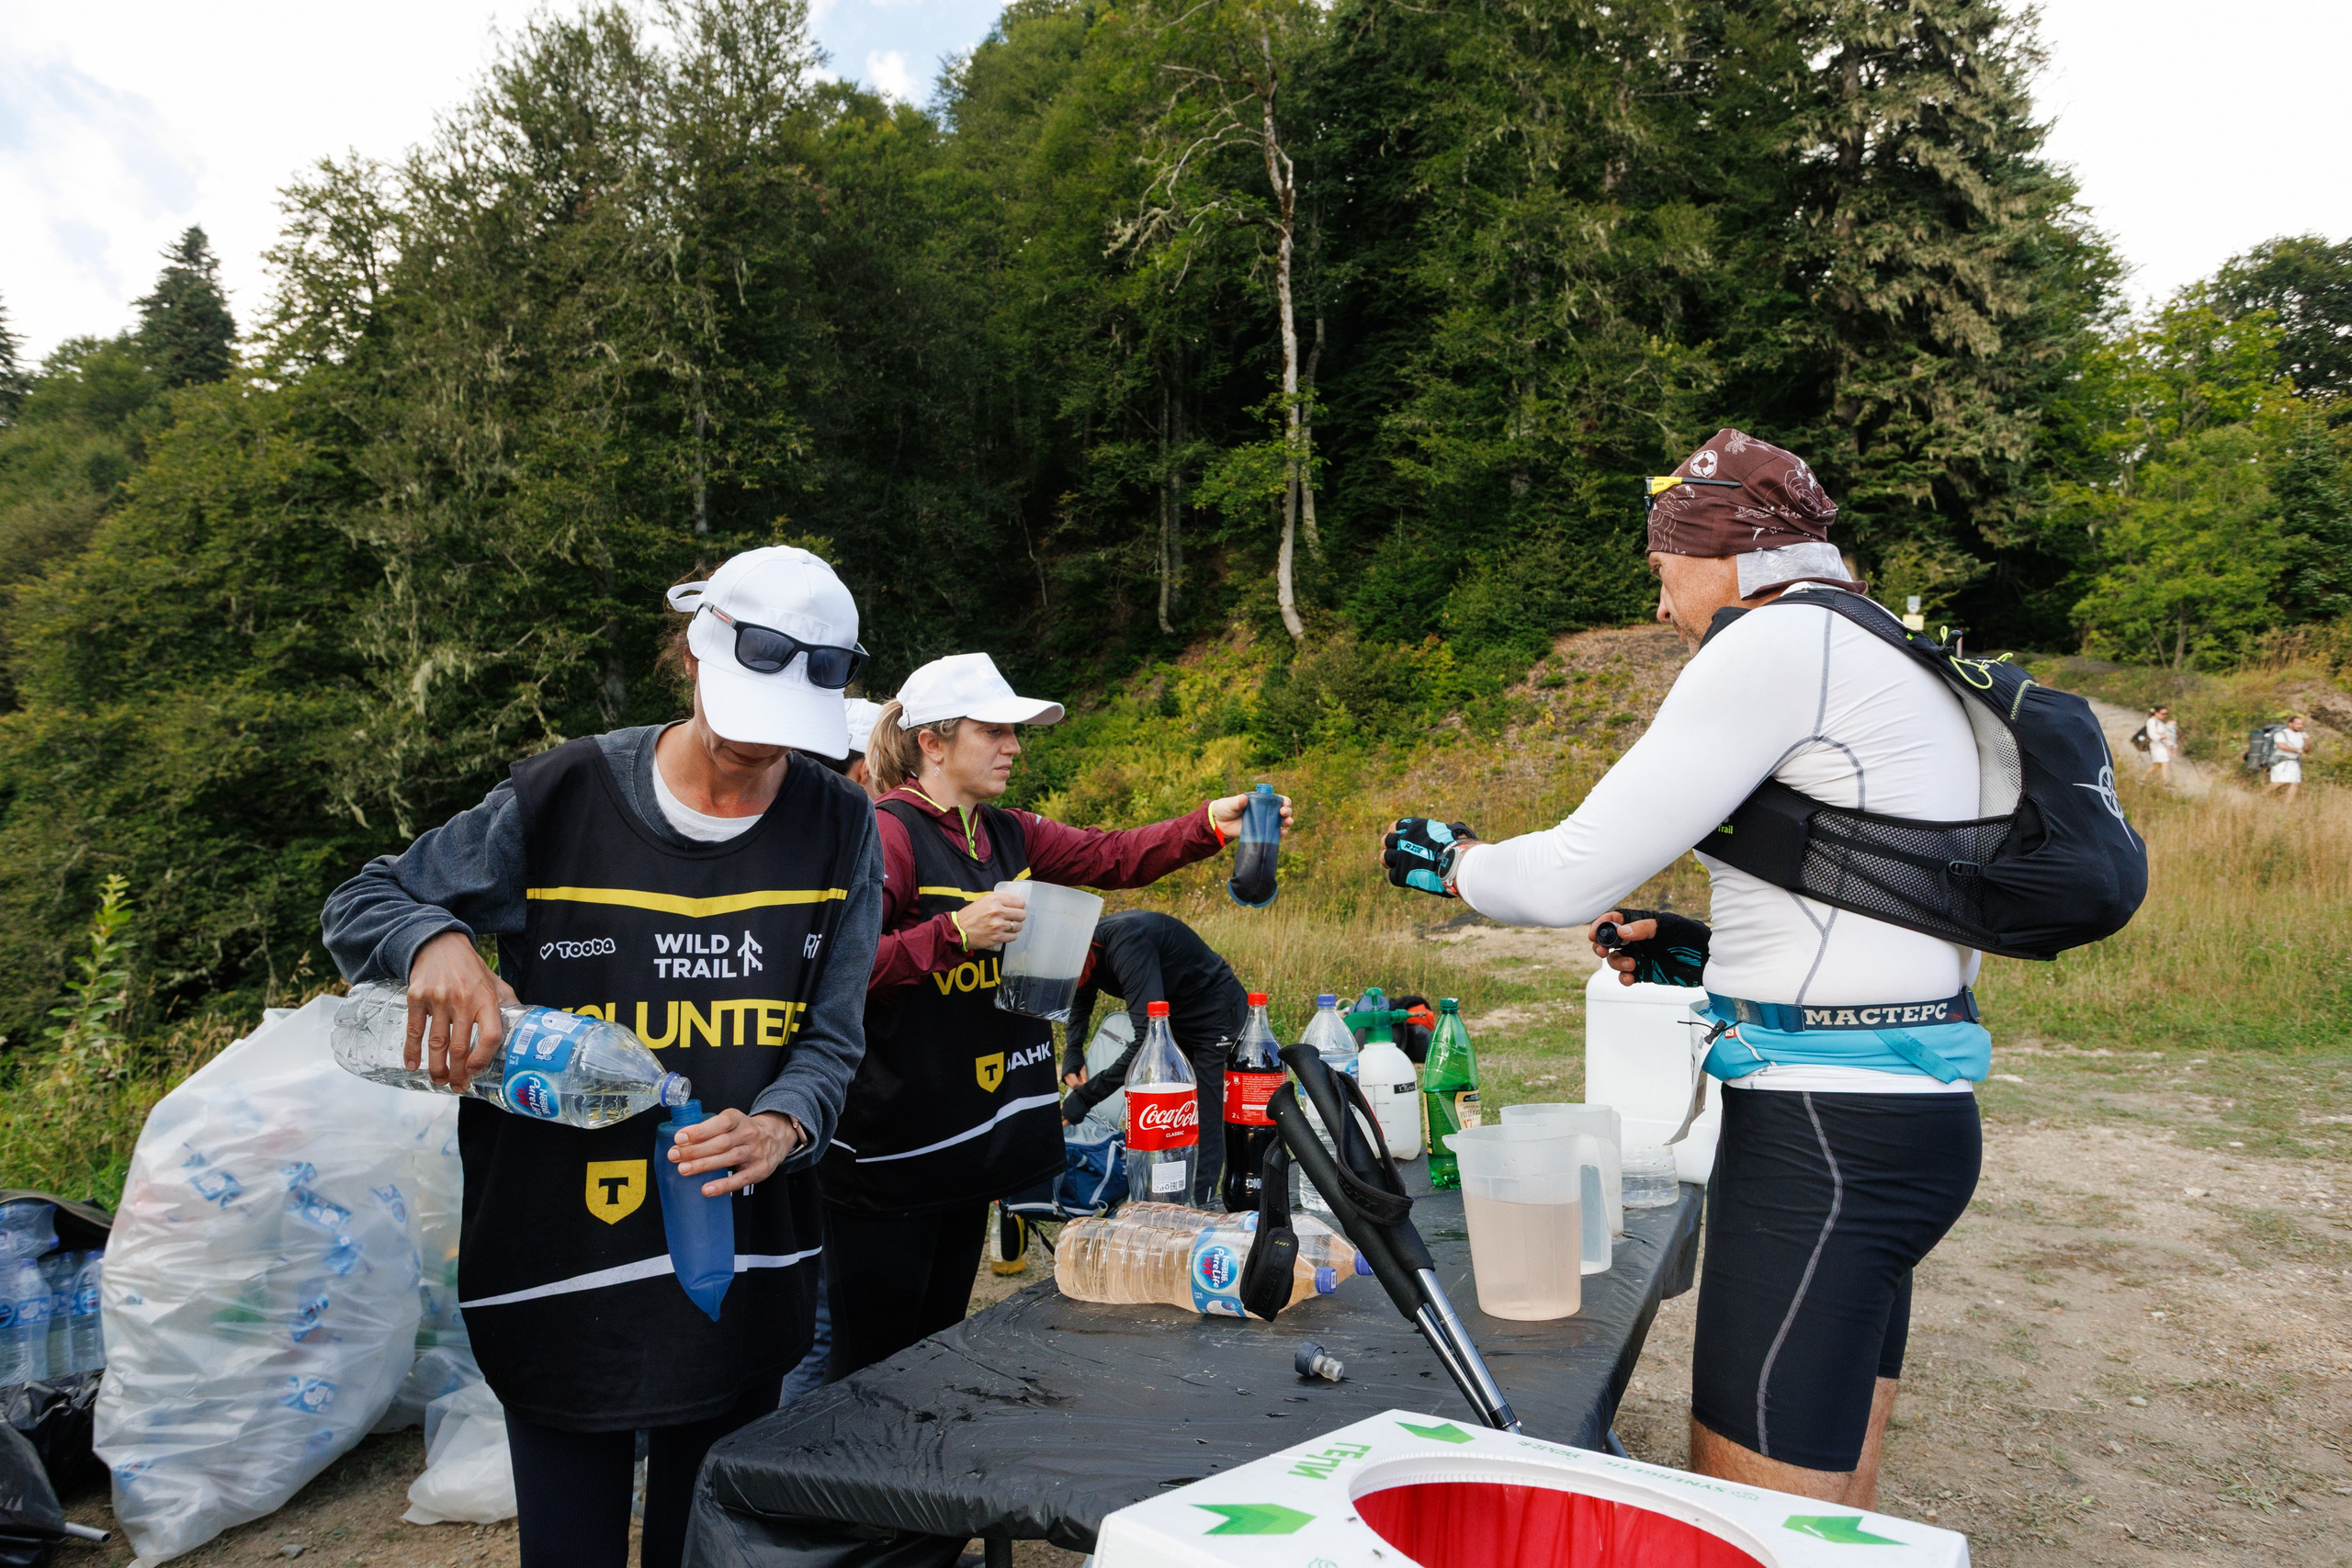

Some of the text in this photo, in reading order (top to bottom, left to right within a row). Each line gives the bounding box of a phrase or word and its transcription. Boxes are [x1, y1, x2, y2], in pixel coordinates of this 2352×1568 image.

[654, 933, 730, 954] WILD
[653, 958, 738, 978] TRAIL
[1006, 1040, 1052, 1073] АНК
[1165, 1130, 1185, 1138] CLASSIC
[1286, 1441, 1373, 1481] ГЕЛИ
[1602, 1460, 1728, 1494] SYNERGETIC
